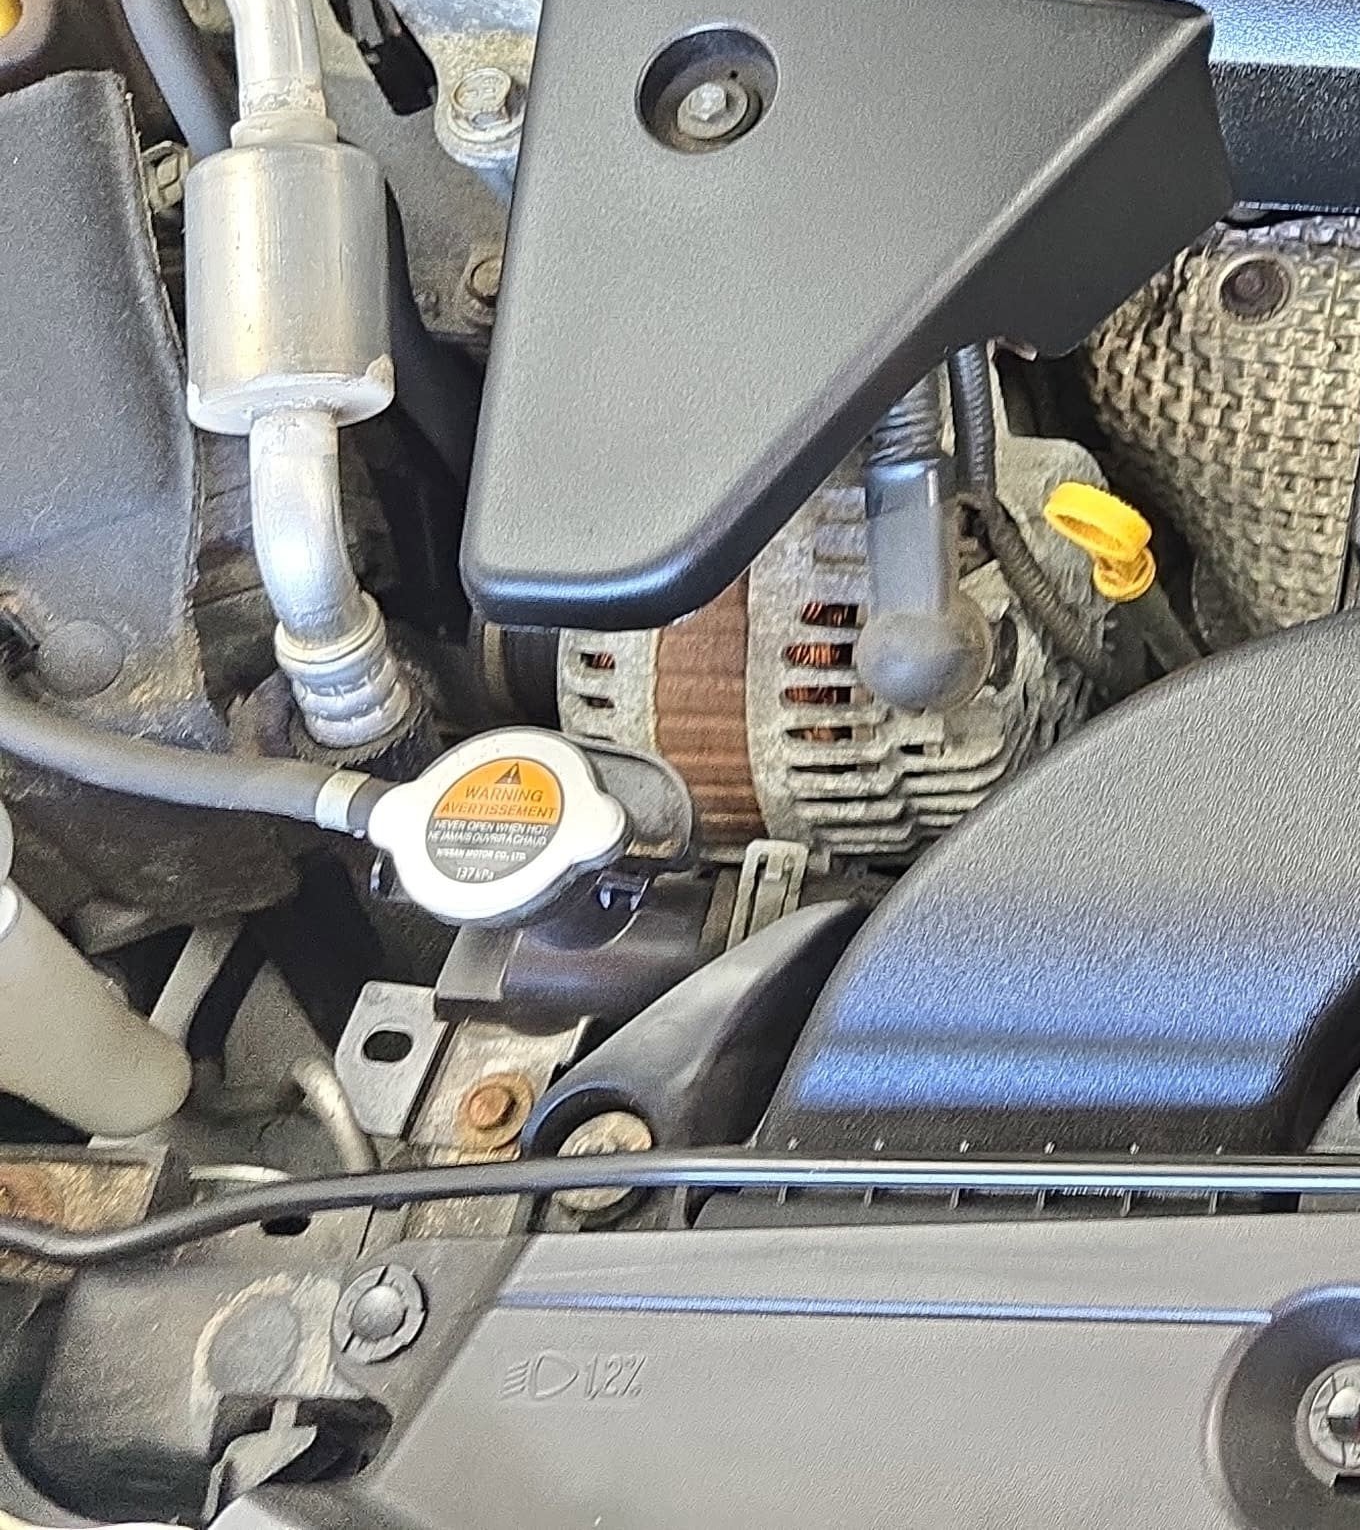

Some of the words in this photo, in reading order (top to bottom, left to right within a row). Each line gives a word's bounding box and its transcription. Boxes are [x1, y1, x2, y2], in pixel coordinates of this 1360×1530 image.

[466, 786, 543, 803] WARNING
[441, 802, 557, 819] AVERTISSEMENT
[434, 820, 465, 830] NEVER
[468, 821, 494, 832] OPEN
[436, 849, 464, 859] NISSAN
